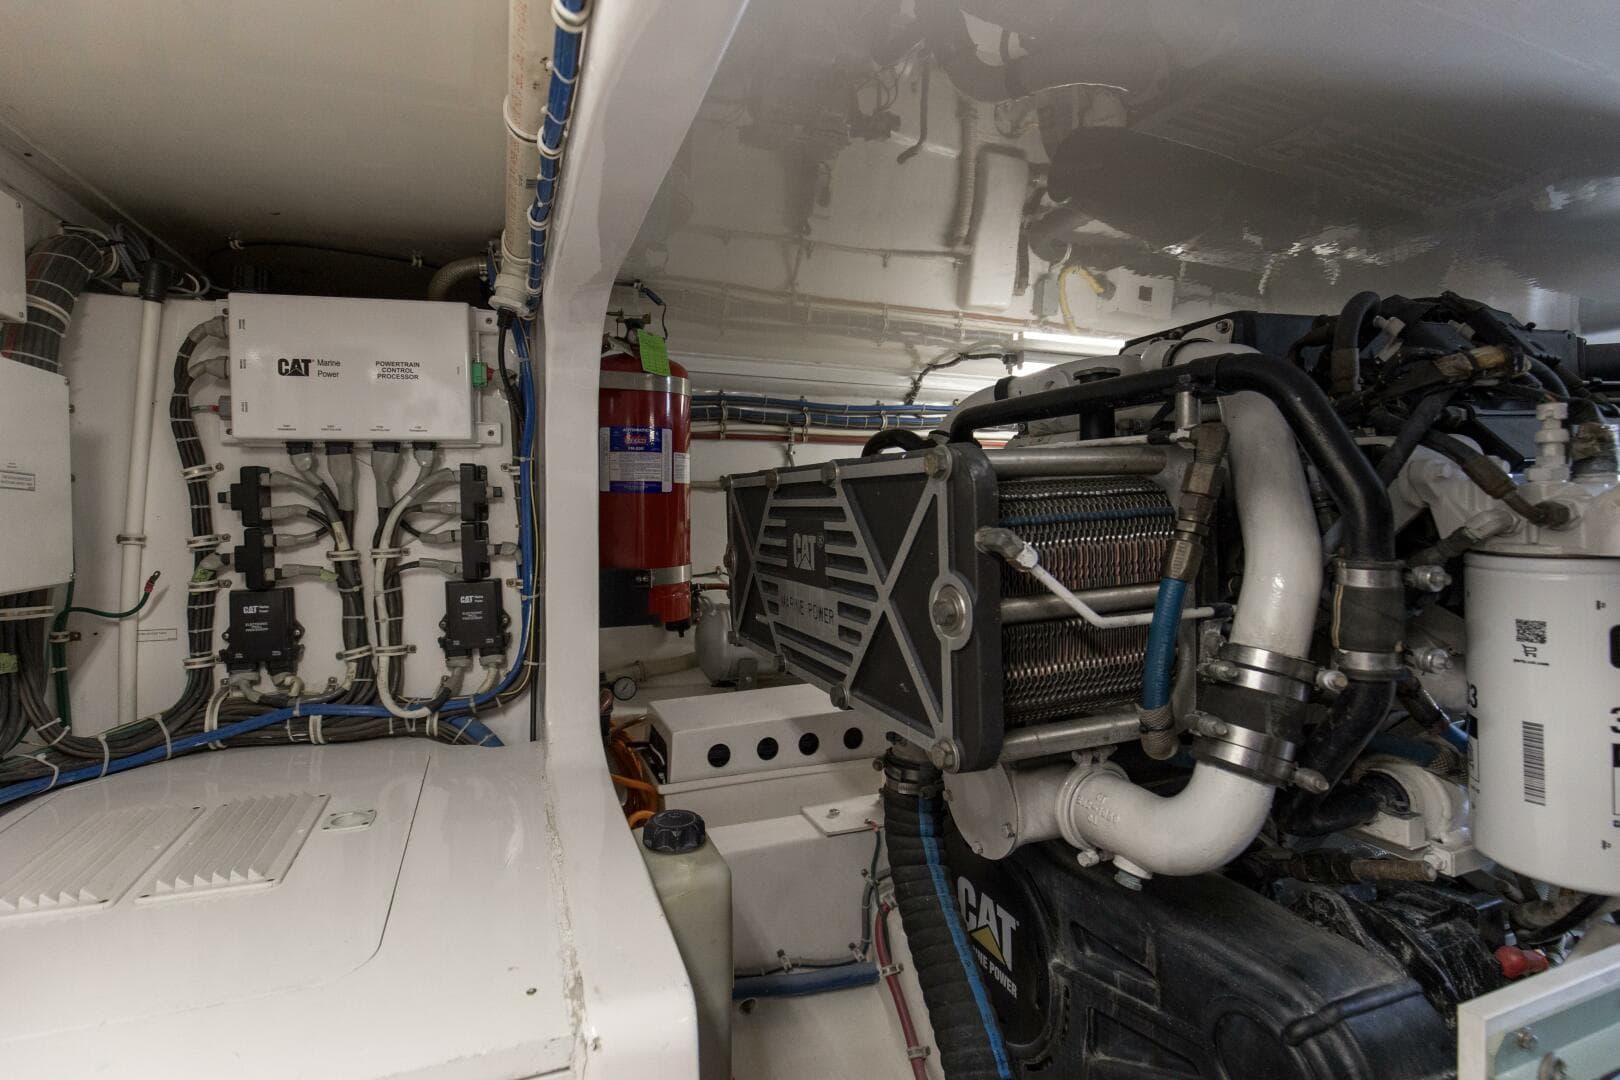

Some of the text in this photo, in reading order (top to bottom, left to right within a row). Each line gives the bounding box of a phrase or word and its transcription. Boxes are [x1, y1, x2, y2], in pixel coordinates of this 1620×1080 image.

[277, 358, 312, 377] CAT
[317, 359, 341, 367] Marine
[375, 360, 420, 368] POWERTRAIN
[317, 370, 339, 378] Power
[808, 601, 834, 624] POWER
[989, 961, 1018, 999] POWER
